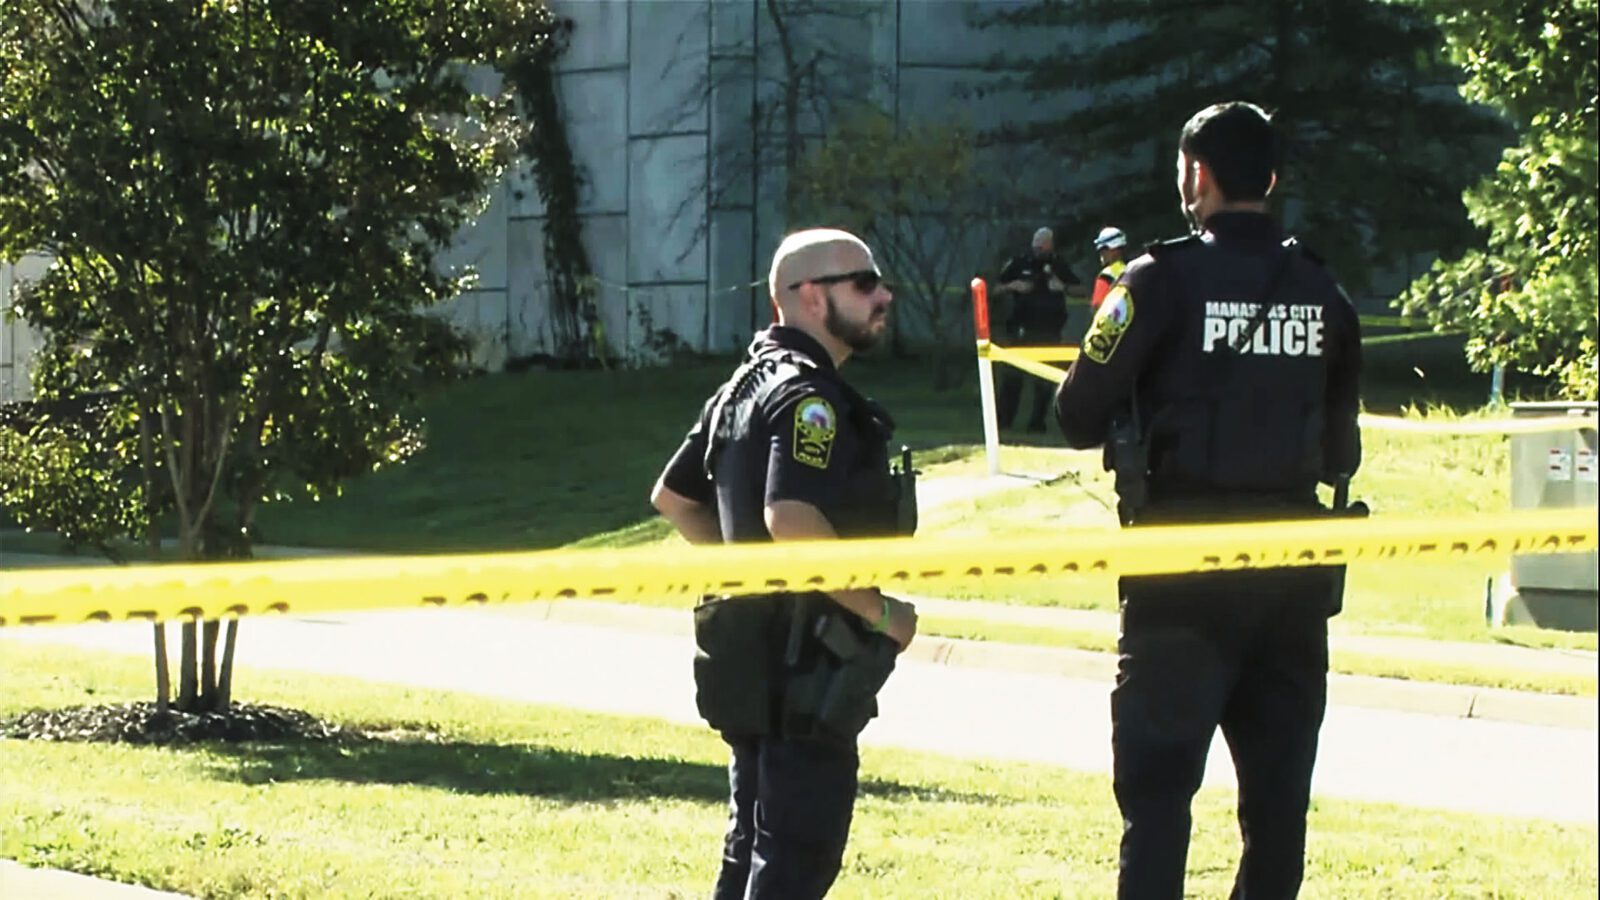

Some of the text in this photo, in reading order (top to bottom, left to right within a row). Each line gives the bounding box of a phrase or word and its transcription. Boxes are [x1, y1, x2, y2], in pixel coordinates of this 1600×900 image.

[1205, 301, 1323, 320] MANASAS CITY
[1203, 318, 1324, 356] POLICE
